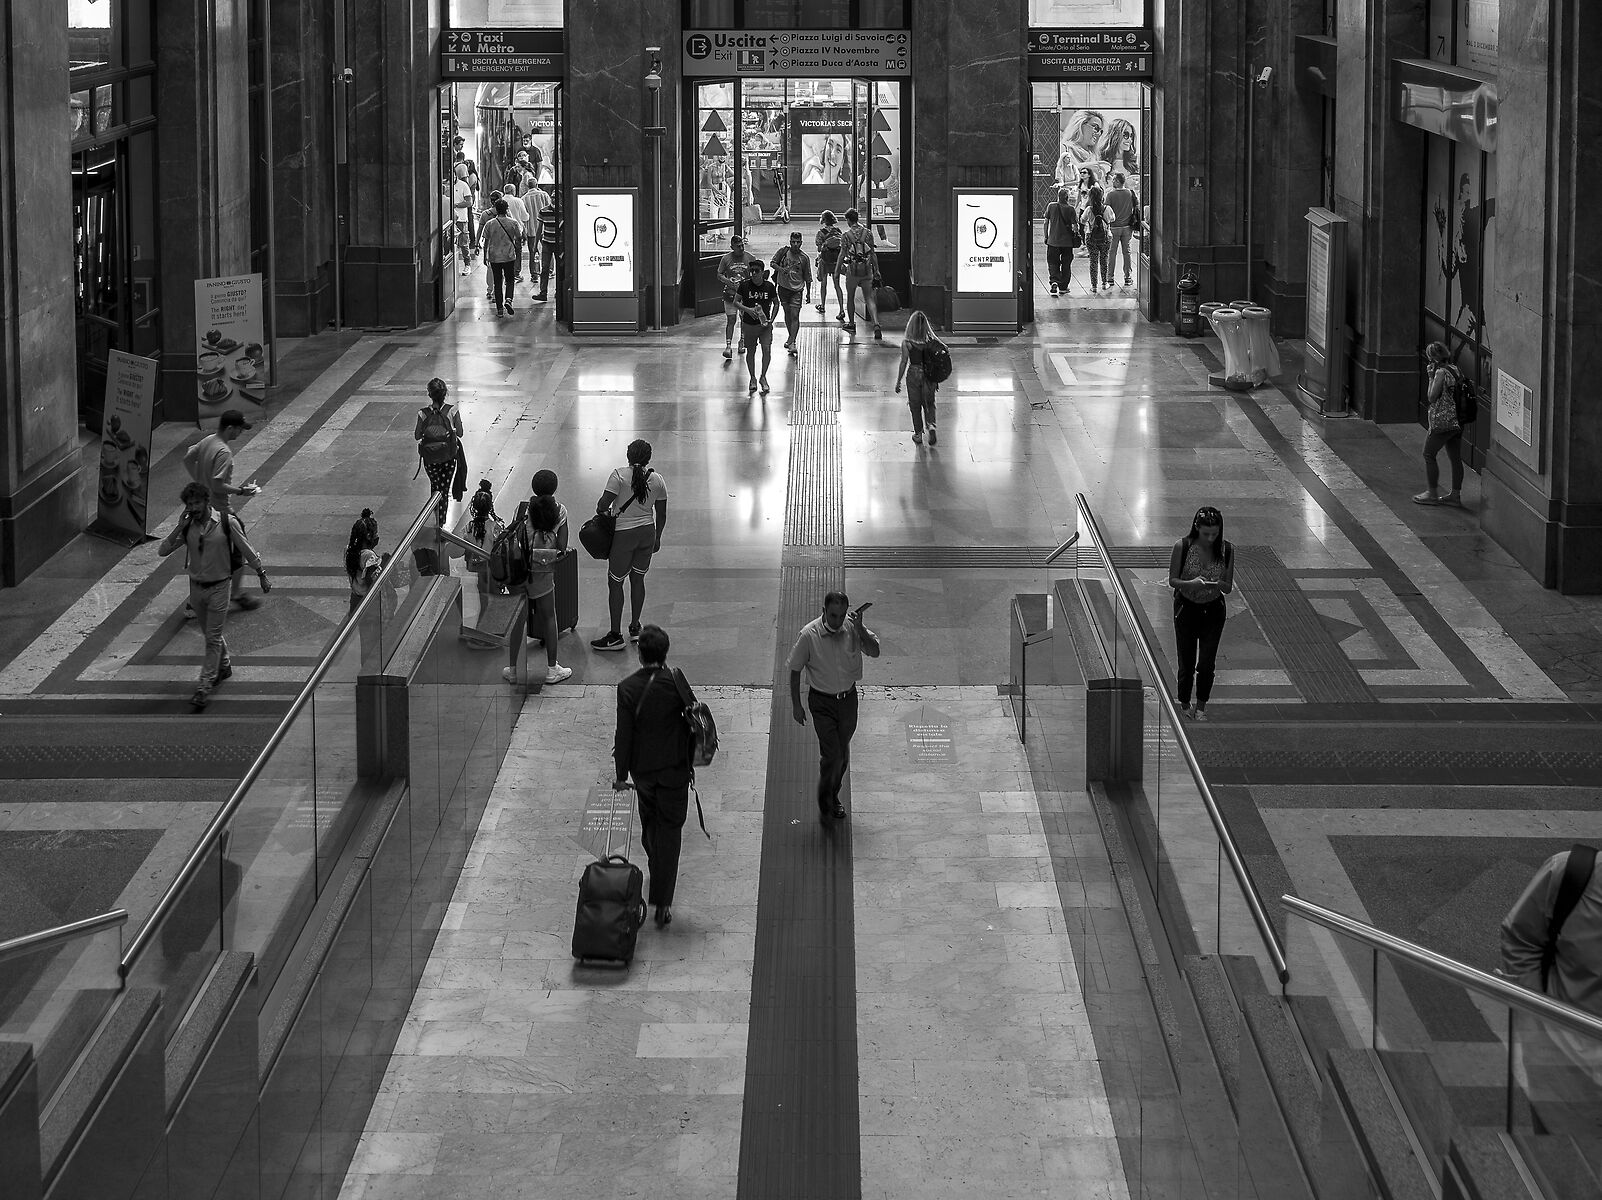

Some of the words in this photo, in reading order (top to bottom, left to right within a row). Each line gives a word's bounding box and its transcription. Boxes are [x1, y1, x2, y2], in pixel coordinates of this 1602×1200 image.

[476, 32, 504, 42] Taxi
[714, 34, 766, 48] Uscita
[822, 34, 842, 43] Luigi
[1052, 34, 1100, 44] Terminal
[1104, 34, 1122, 44] Bus
[478, 44, 514, 53] Metro
[714, 50, 732, 60] Exit
